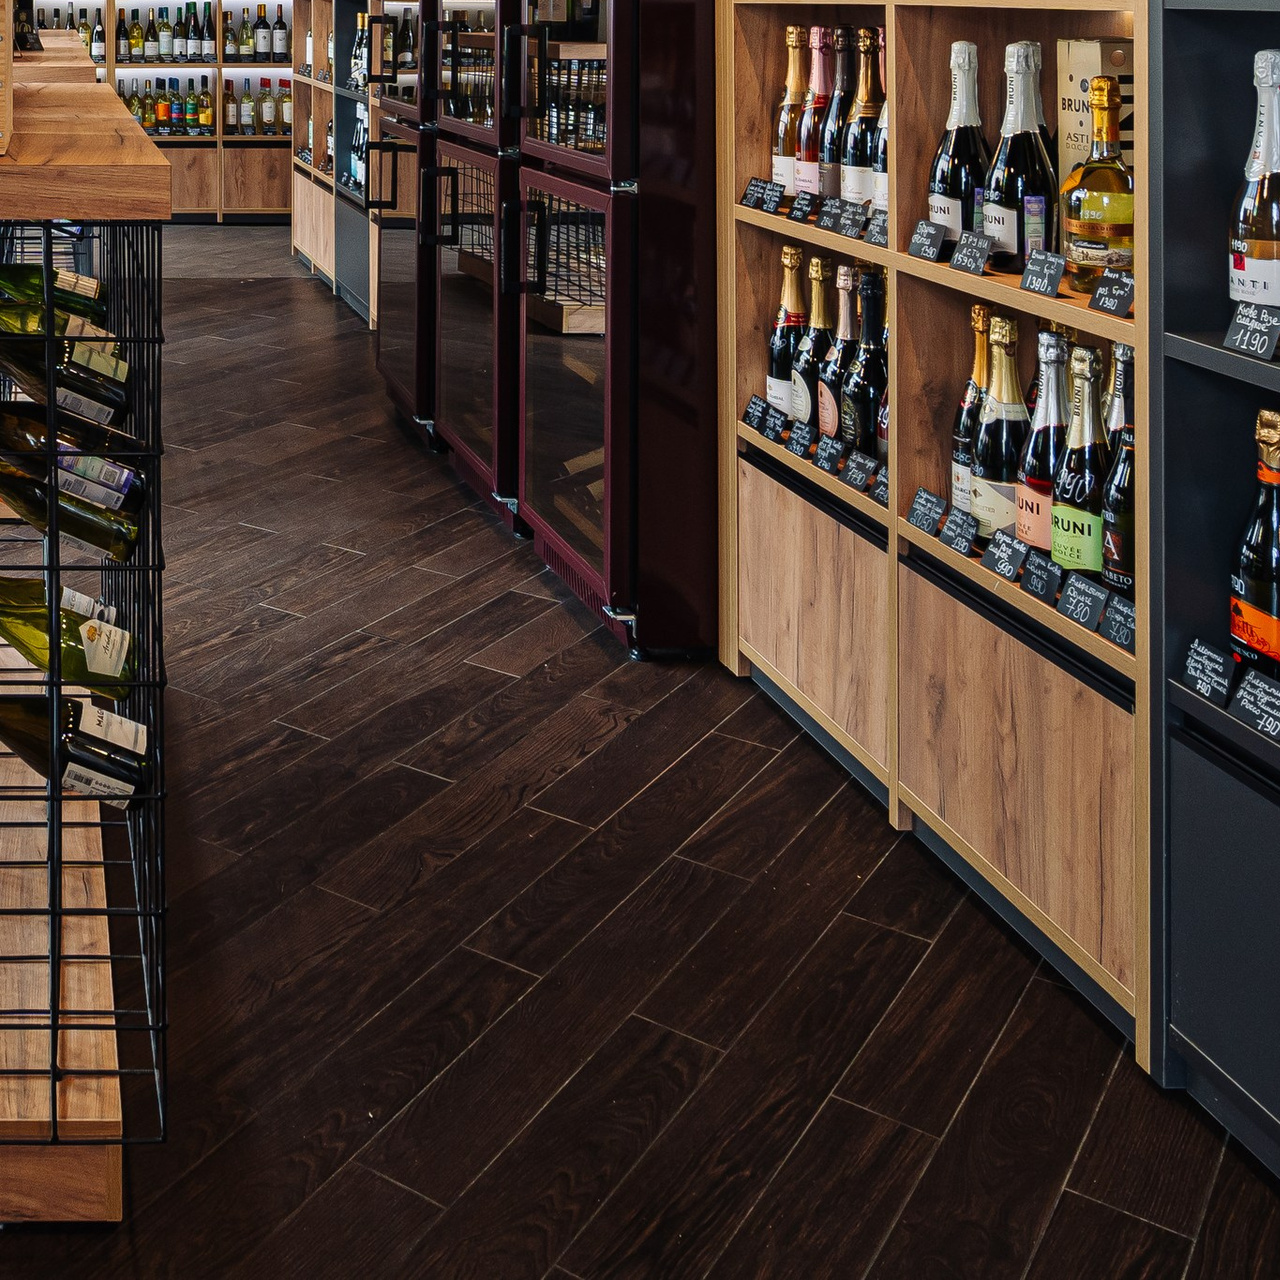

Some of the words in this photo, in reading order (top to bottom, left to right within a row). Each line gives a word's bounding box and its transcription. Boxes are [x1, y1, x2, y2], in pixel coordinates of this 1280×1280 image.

[1061, 97, 1089, 113] BRUN
[1255, 103, 1265, 149] CANTI
[930, 204, 950, 215] RUNI
[984, 214, 1005, 225] RUNI
[1232, 328, 1269, 355] 1190
[1116, 369, 1124, 399] BRUNI
[1074, 385, 1082, 417] BRUNI
[1055, 469, 1095, 504] 990
[1018, 496, 1040, 516] UNI
[995, 560, 1014, 577] 990
[1065, 597, 1090, 622] 780
[1109, 621, 1132, 645] 780
